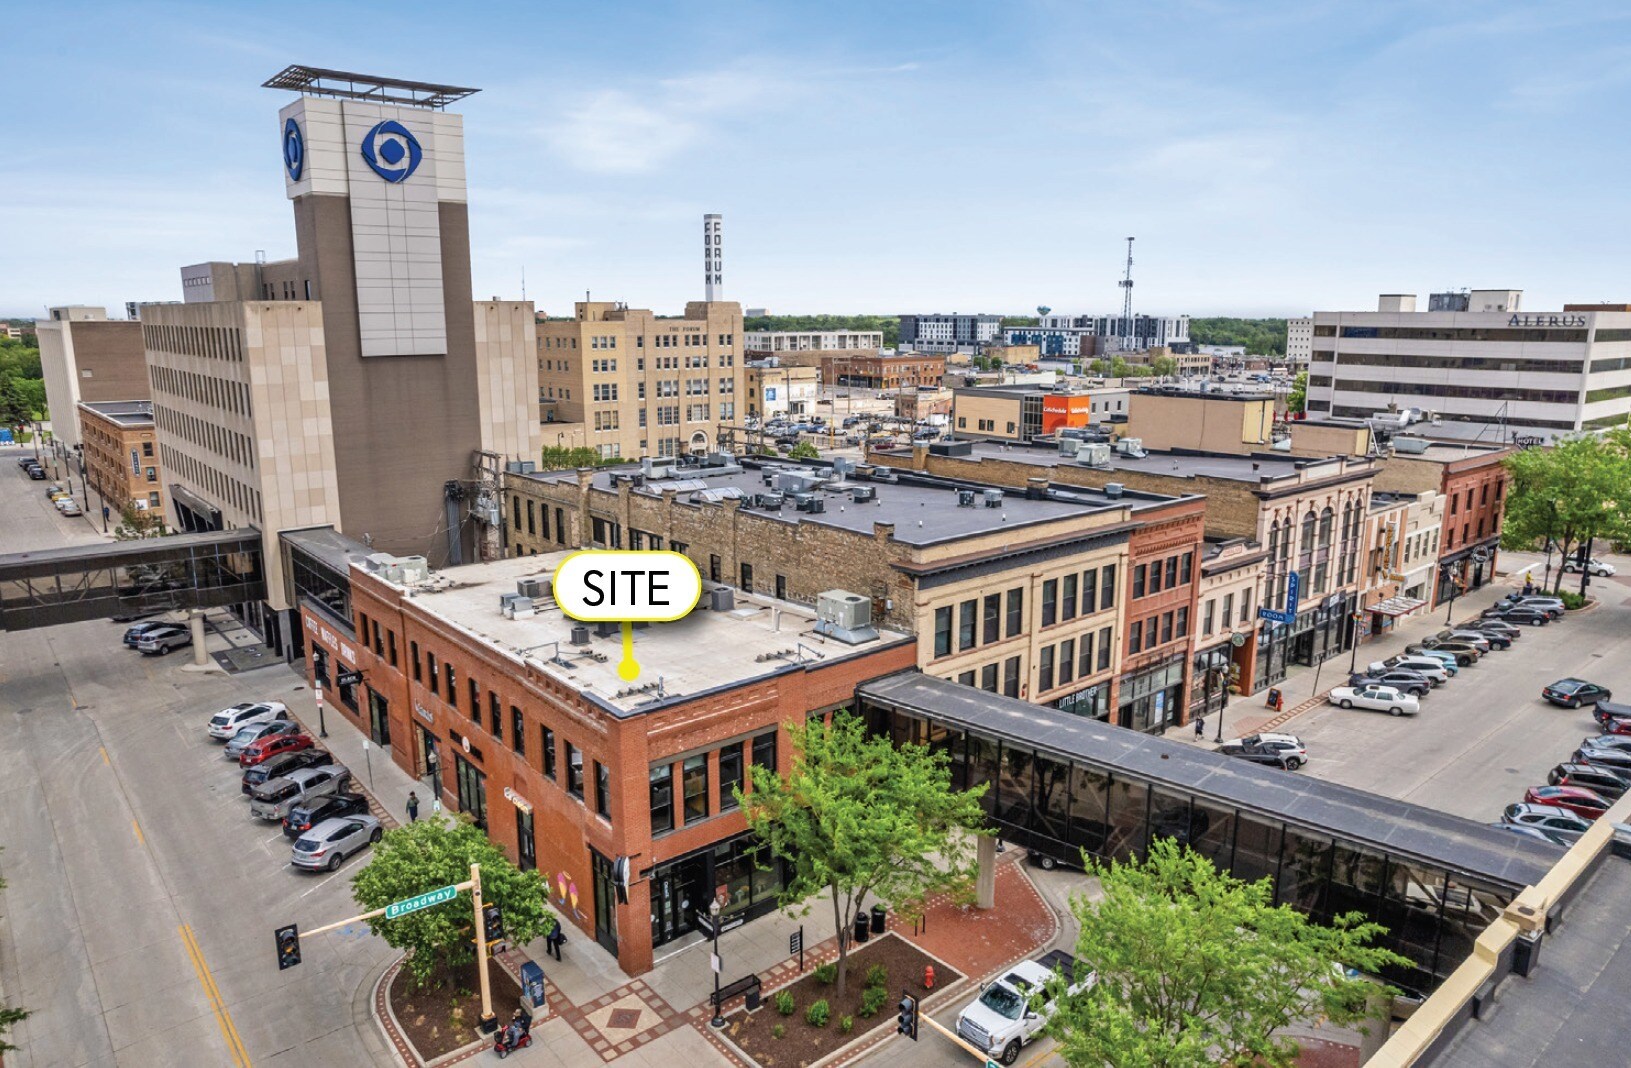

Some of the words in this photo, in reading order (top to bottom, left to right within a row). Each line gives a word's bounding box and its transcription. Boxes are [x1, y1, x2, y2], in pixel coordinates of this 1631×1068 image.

[704, 222, 712, 285] FORUM
[714, 222, 722, 285] FORUM
[1508, 314, 1586, 327] ALERUS
[1517, 437, 1544, 445] HOTEL
[1288, 576, 1296, 614] SPIRIT
[1262, 611, 1284, 621] ROOM
[1059, 694, 1075, 709] LITTLE
[1076, 687, 1098, 702] BROTHER
[391, 888, 451, 916] Broadway
